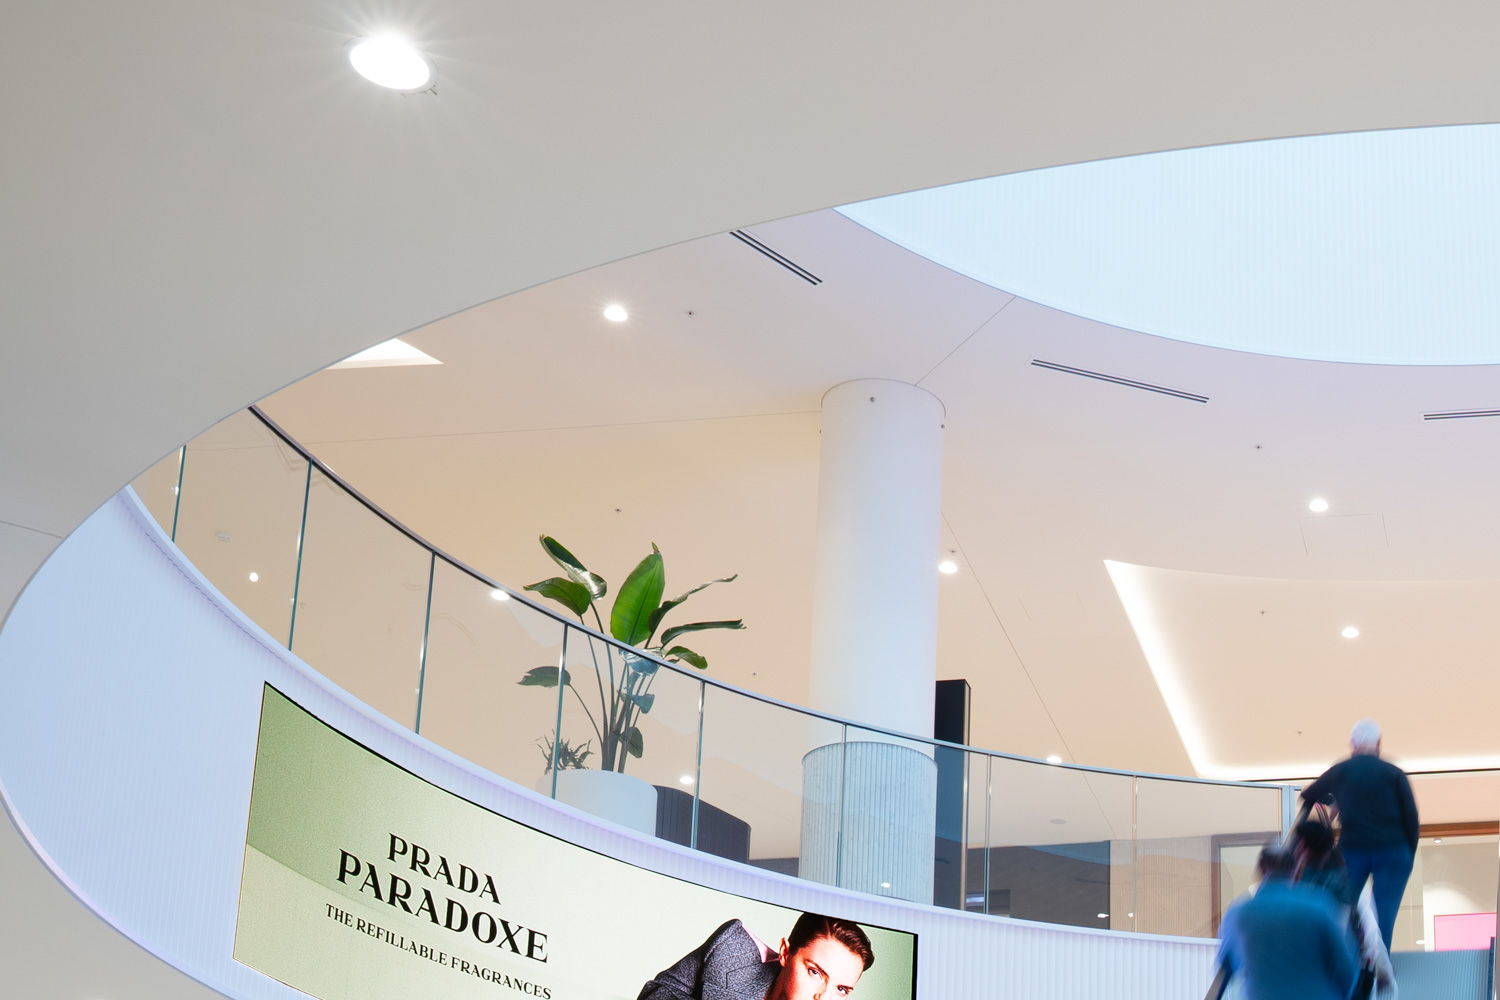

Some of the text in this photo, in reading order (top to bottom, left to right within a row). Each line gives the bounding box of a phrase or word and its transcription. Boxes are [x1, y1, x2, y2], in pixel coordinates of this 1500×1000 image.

[336, 848, 549, 964] PARADOXE
[387, 832, 502, 905] PRADA
[326, 903, 552, 1000] THE REFILLABLE FRAGRANCES
